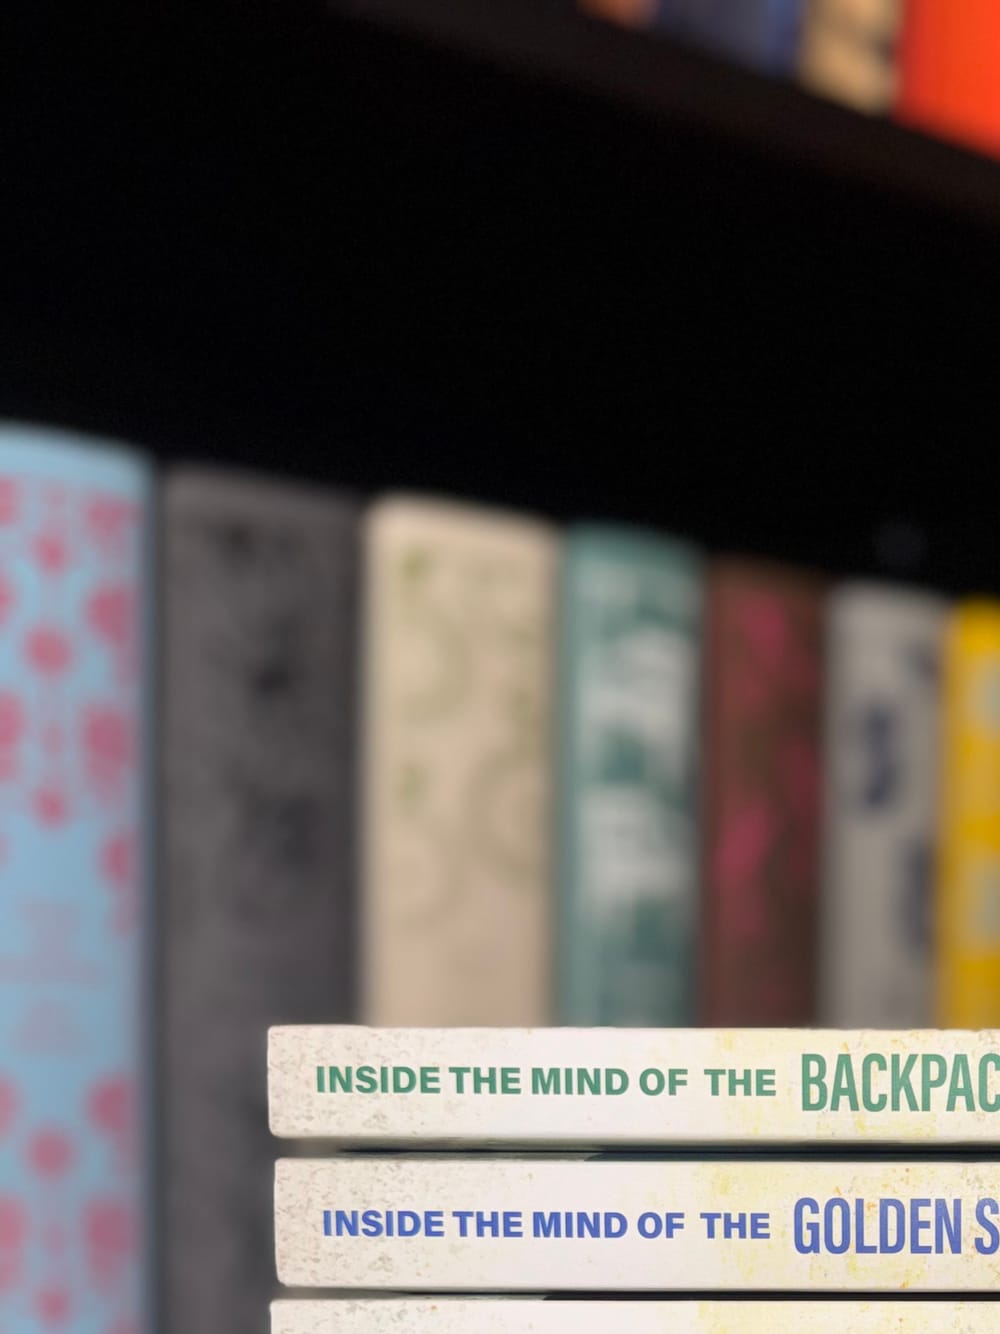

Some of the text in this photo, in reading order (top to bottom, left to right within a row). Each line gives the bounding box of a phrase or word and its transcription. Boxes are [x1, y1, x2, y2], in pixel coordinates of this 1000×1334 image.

[315, 1066, 441, 1094] INSIDE
[448, 1067, 521, 1095] THE
[530, 1067, 630, 1096] MIND
[637, 1067, 688, 1096] OF
[703, 1068, 777, 1096] THE
[322, 1210, 444, 1237] INSIDE
[452, 1210, 523, 1238] THE
[533, 1211, 630, 1239] MIND
[637, 1211, 685, 1239] OF
[701, 1212, 770, 1240] THE
[793, 1197, 962, 1255] GOLDEN
